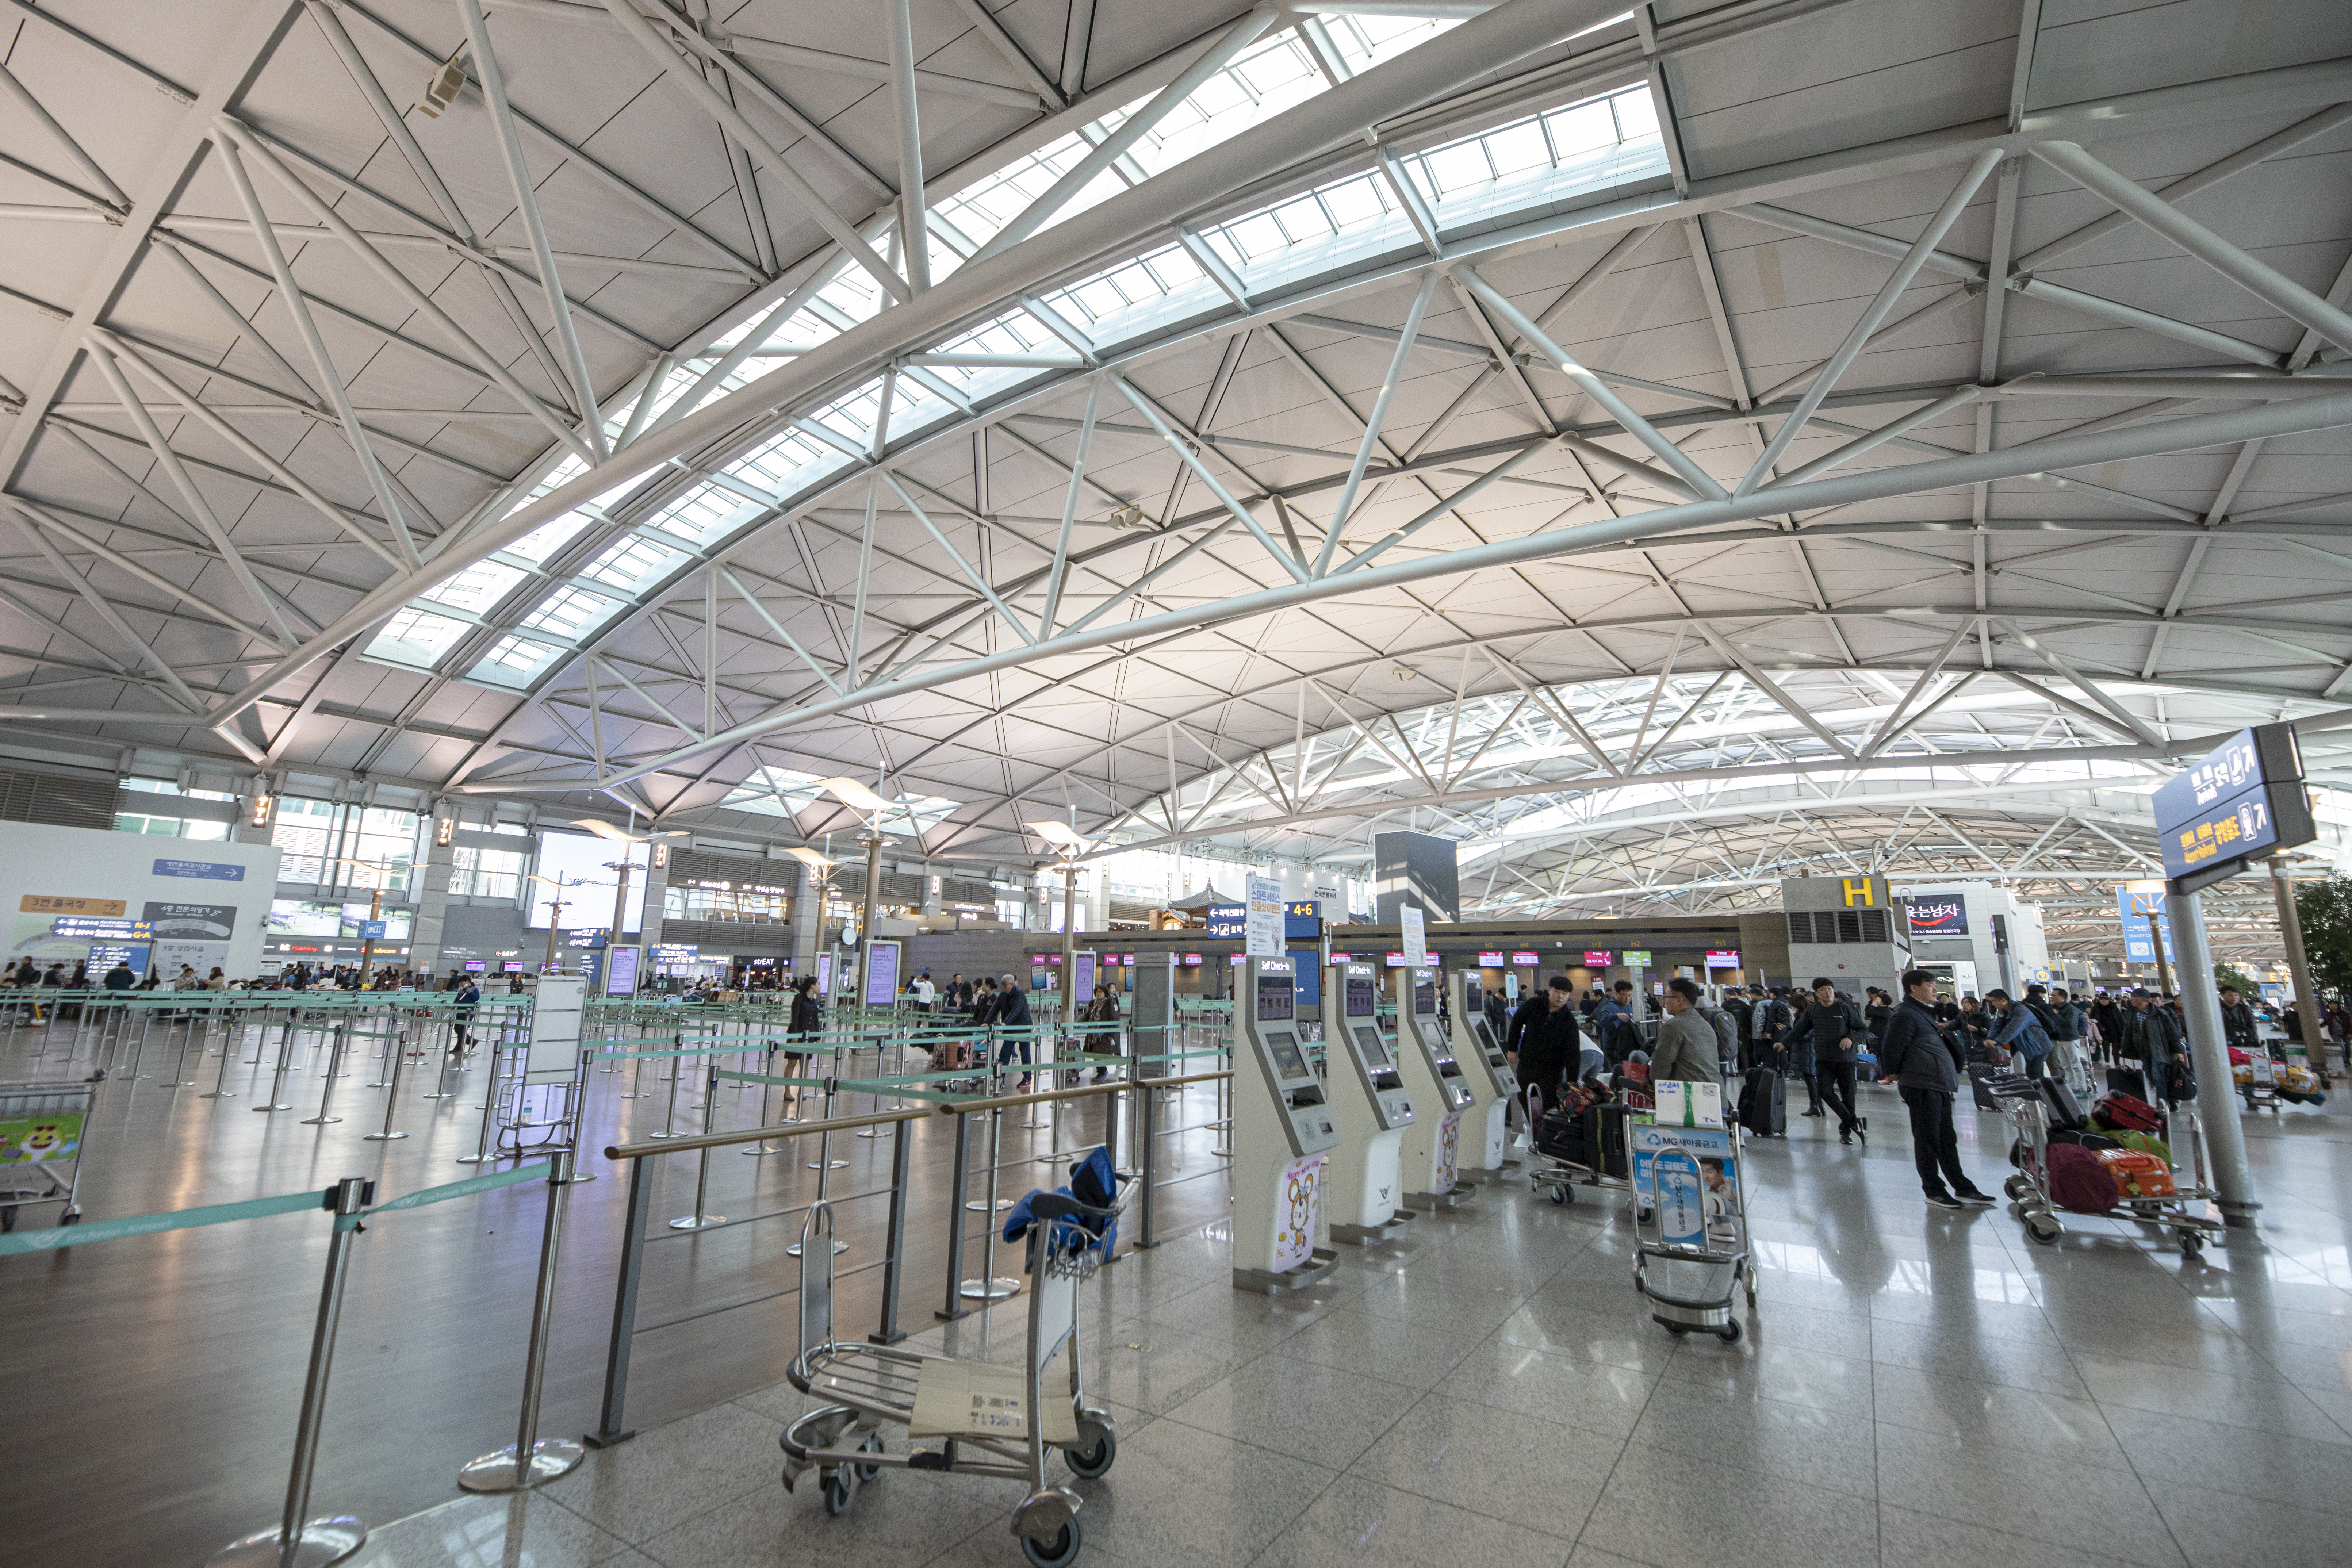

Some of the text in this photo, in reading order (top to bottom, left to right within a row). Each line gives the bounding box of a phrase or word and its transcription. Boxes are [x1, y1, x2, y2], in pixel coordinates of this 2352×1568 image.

[2214, 762, 2230, 787] 도착
[2197, 784, 2218, 805] Arrivals
[2214, 816, 2241, 845] 공항철도
[1314, 891, 1336, 899] 한국문화거리
[1843, 878, 1873, 906] H
[1252, 901, 1281, 915] 인증샷 이벤트
[1294, 904, 1313, 916] 4-6
[1261, 960, 1290, 971] Self Check-In
[1355, 966, 1371, 975] Check-In
[2268, 972, 2277, 981] E
[1662, 1137, 1718, 1149] MG 새마을금고
[1288, 1171, 1300, 1180] HAPPY
[1301, 1164, 1310, 1174] NEW
